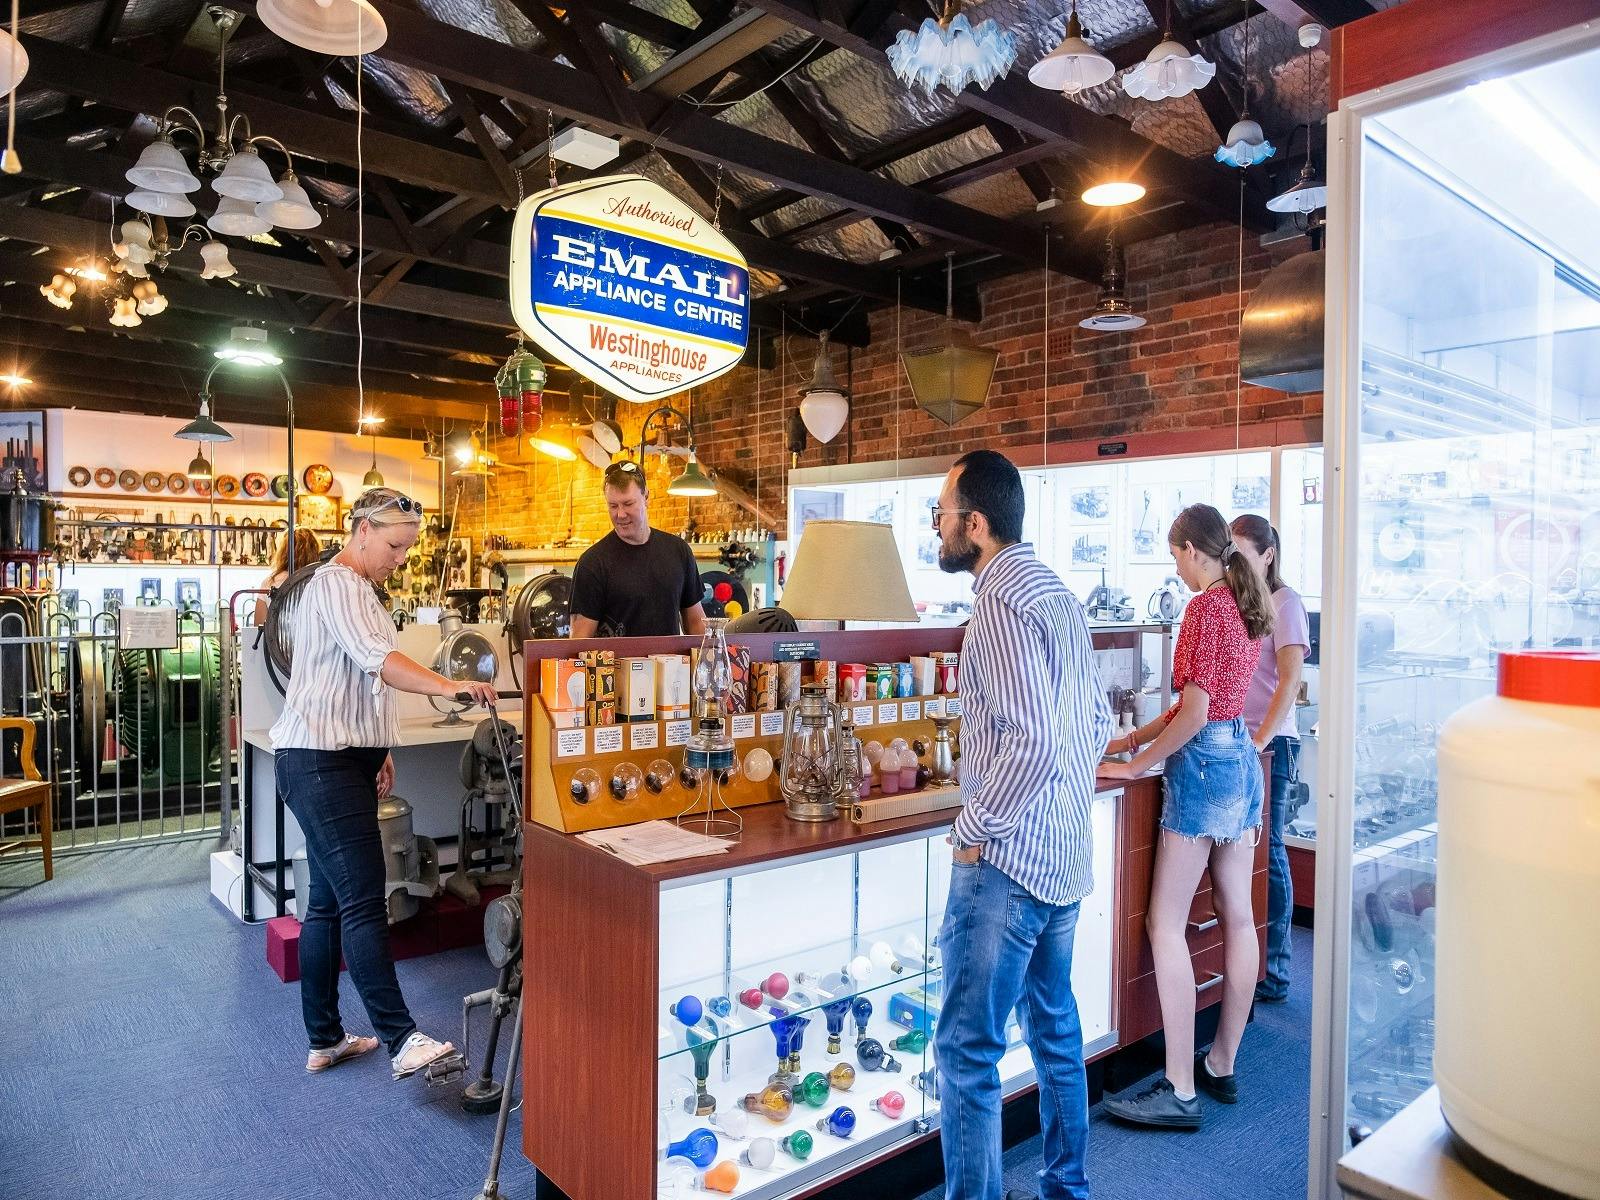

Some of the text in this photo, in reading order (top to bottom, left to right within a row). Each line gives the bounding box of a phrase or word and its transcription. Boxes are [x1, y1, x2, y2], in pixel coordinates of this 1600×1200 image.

[602, 196, 698, 238] Authorised
[551, 234, 745, 307] EMAIL
[552, 270, 743, 331] APPLIANCE CENTRE
[589, 323, 708, 372] Westinghouse
[609, 360, 682, 383] APPLIANCES
